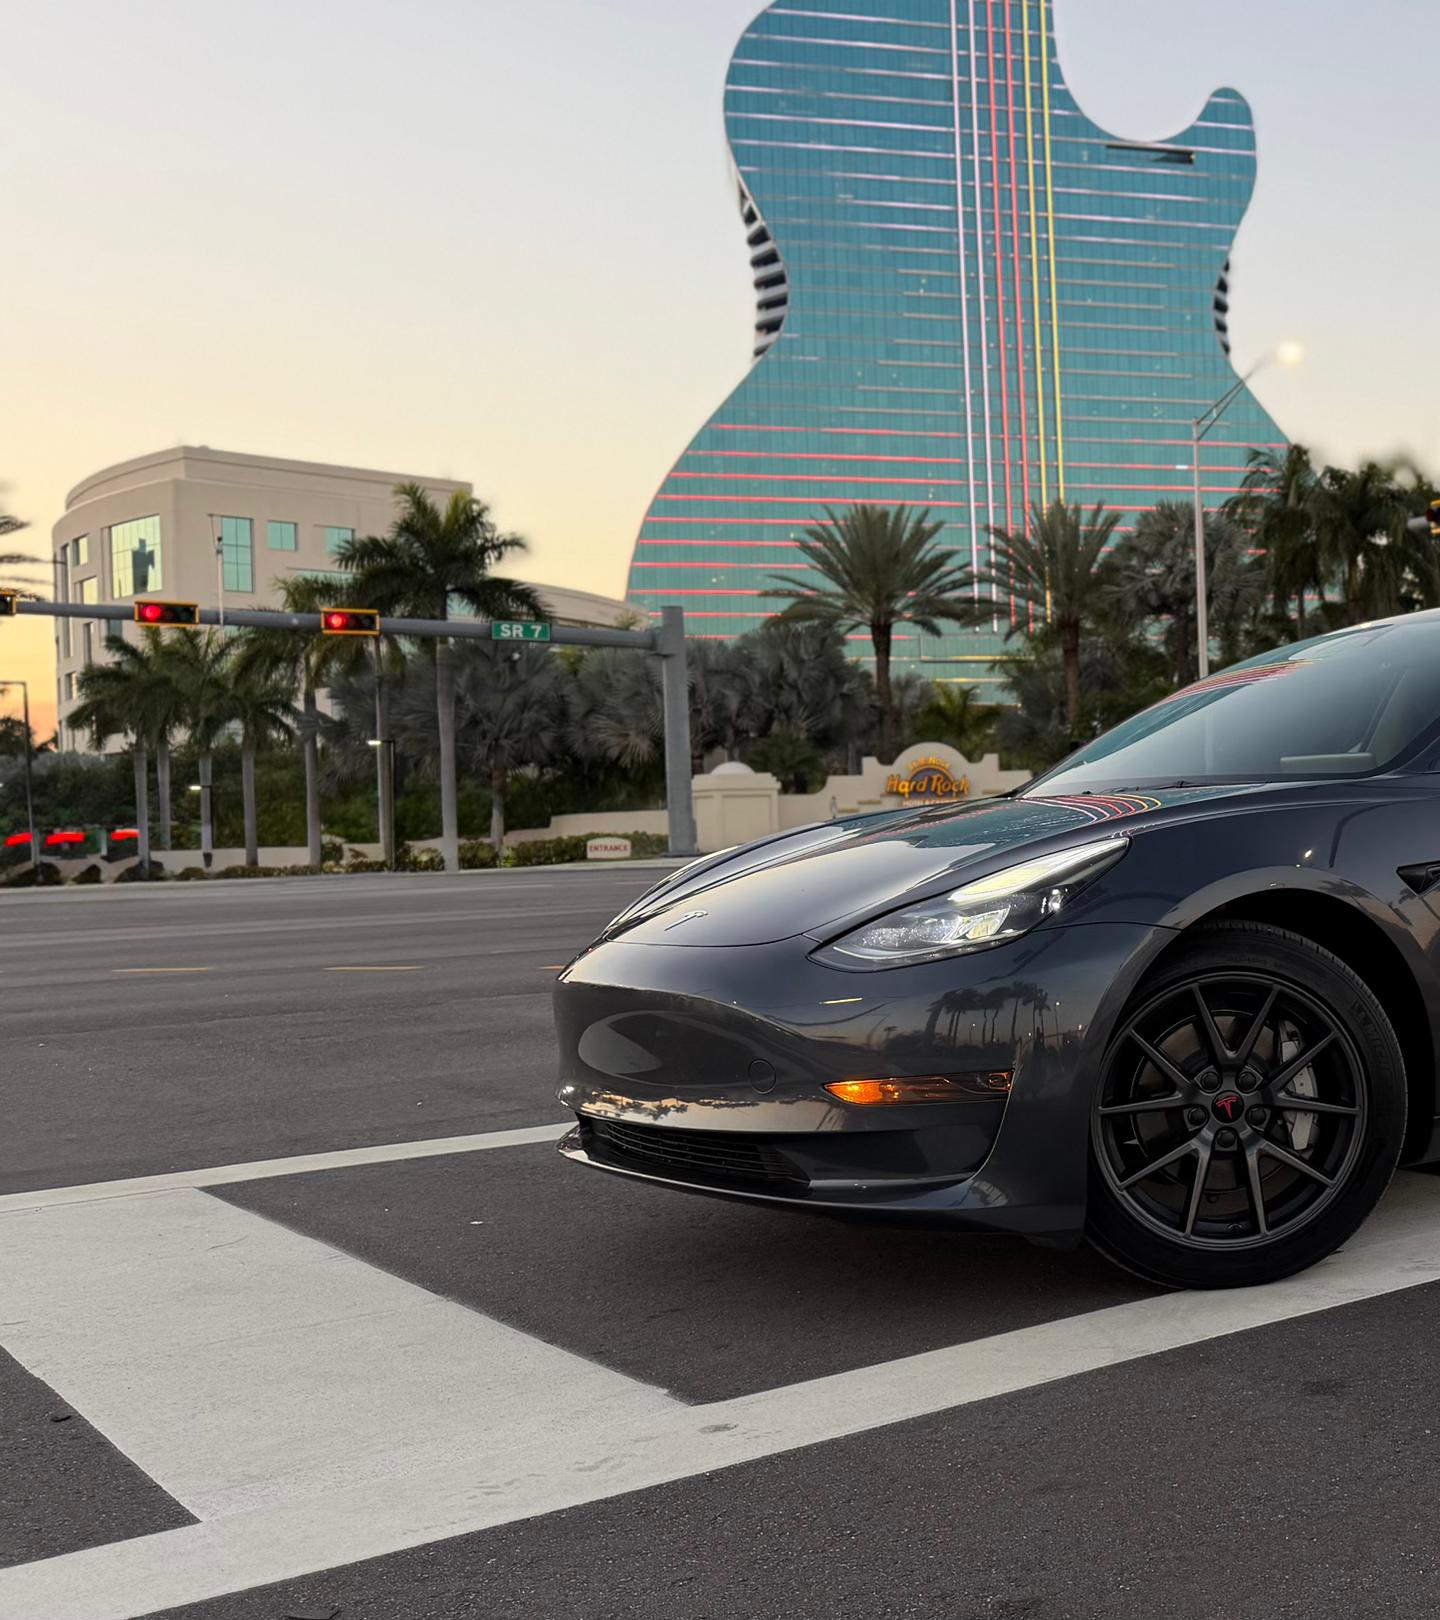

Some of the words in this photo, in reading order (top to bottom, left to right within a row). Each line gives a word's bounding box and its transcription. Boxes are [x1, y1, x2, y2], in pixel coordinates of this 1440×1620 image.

[500, 624, 524, 638] SR
[530, 625, 542, 639] 7
[886, 774, 928, 799] Hard
[930, 774, 969, 797] Rock
[589, 844, 627, 852] ENTRANCE
